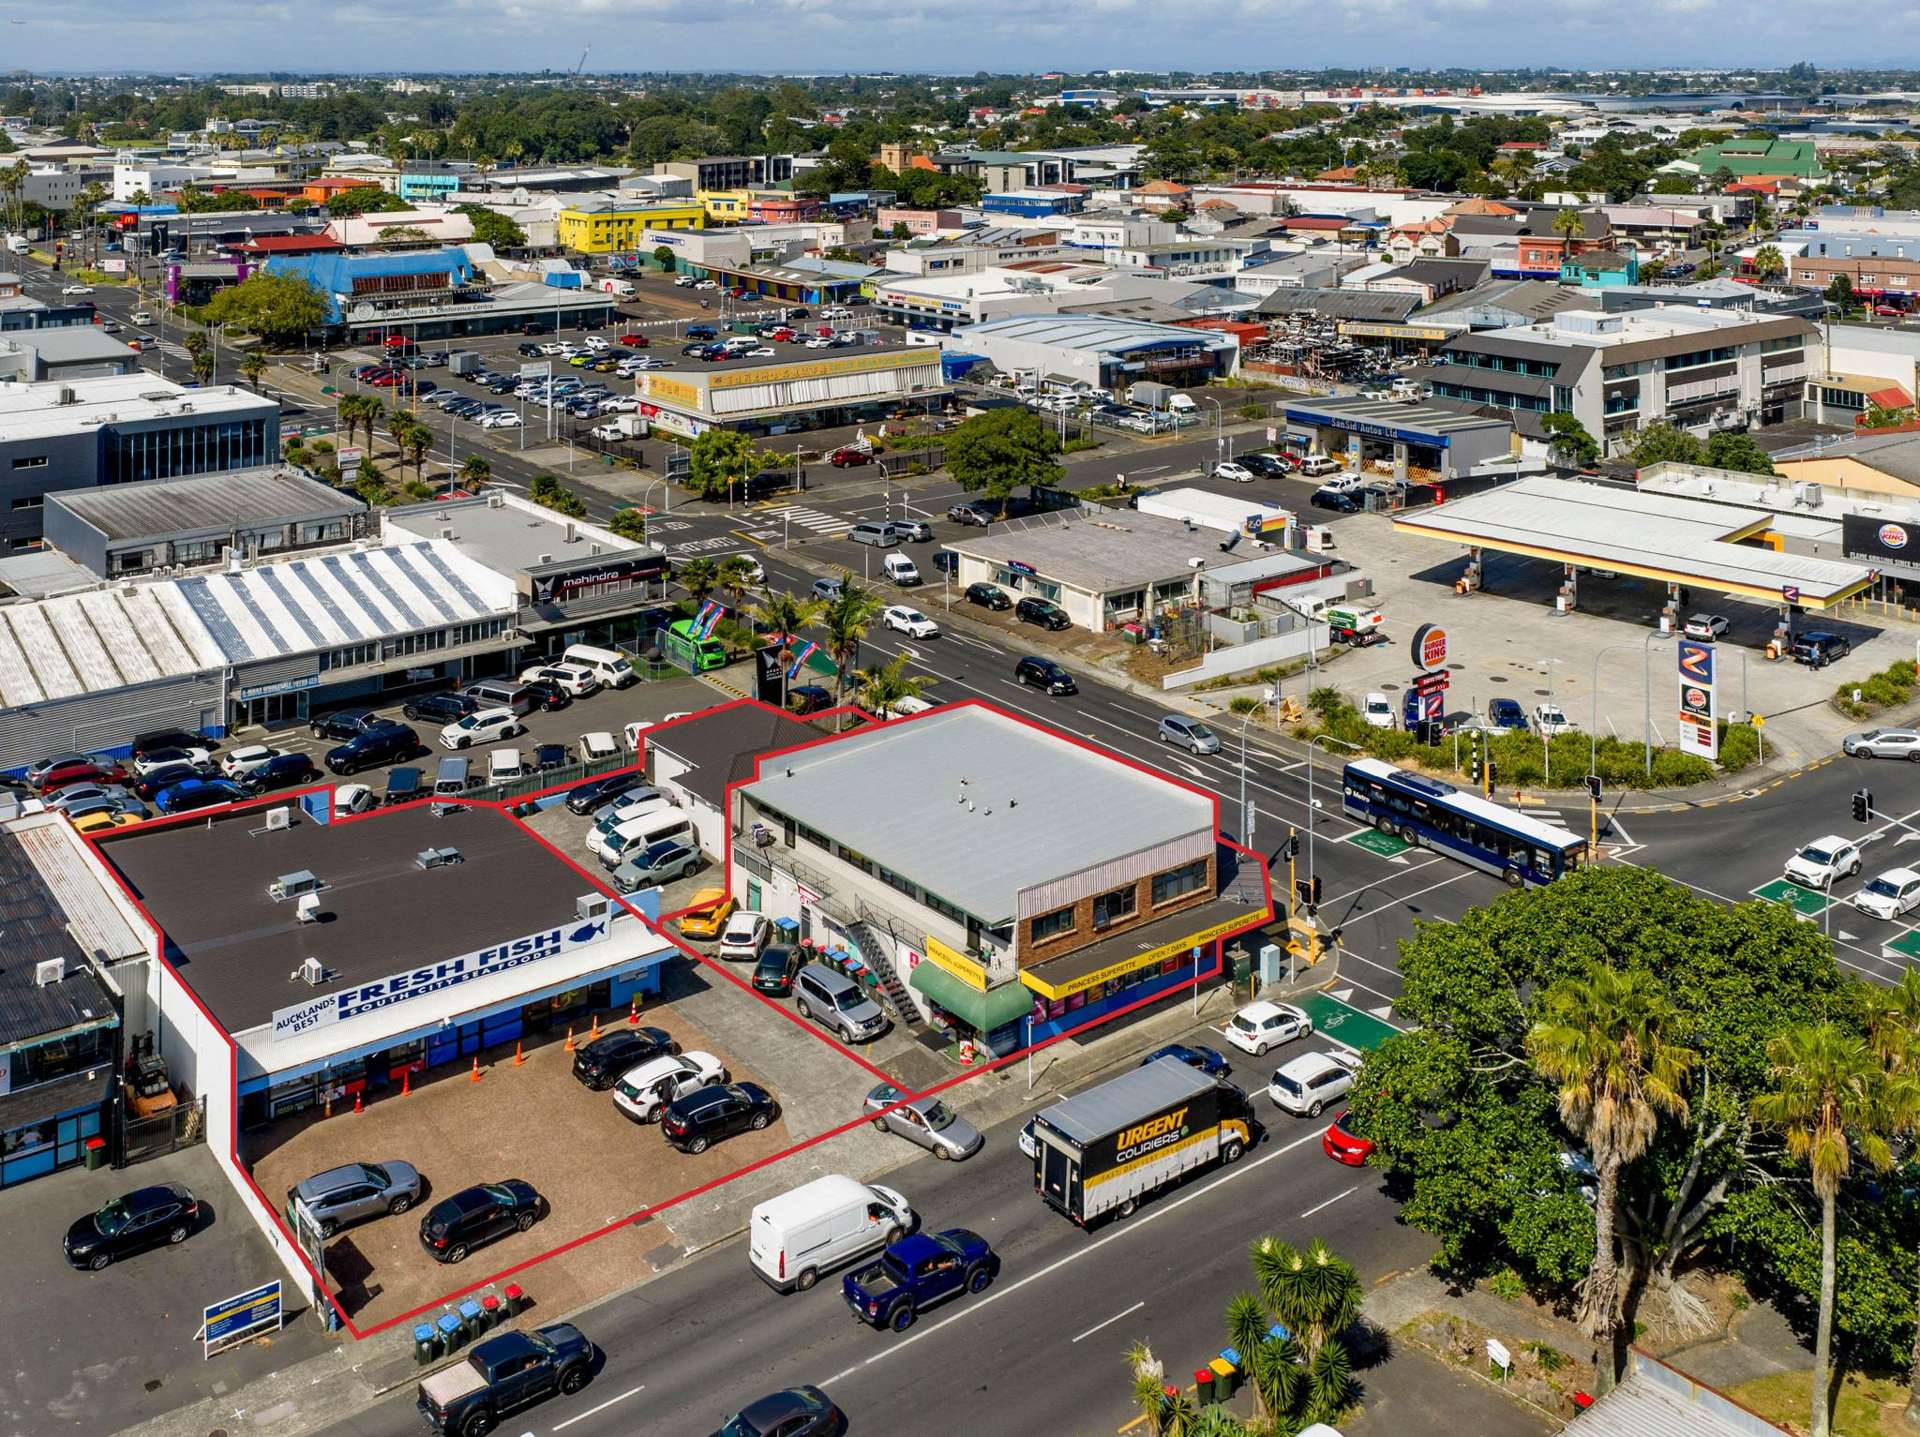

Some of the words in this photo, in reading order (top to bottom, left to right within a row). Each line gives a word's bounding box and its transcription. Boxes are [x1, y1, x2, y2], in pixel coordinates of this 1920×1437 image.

[406, 308, 428, 316] Events
[436, 304, 472, 314] Conference
[1391, 327, 1424, 338] SPARES
[1331, 416, 1357, 431] SanSid
[1360, 424, 1383, 436] Autos
[1385, 427, 1398, 439] Ltd
[1881, 533, 1904, 542] KING
[1895, 559, 1912, 568] SINCE
[563, 571, 619, 587] mahindra
[1424, 639, 1446, 650] BURGER
[1424, 646, 1446, 661] KING
[1681, 647, 1708, 676] Z
[1352, 790, 1370, 803] Metro
[1198, 926, 1227, 942] PRINCESS
[1228, 913, 1260, 933] SUPERETTE
[1148, 949, 1164, 962] OPEN
[1171, 941, 1187, 955] DAYS
[338, 958, 465, 1009] FRESH
[479, 930, 561, 966] FISH
[1067, 973, 1099, 992] PRINCESS
[1101, 960, 1137, 982] SUPERETTE
[350, 993, 409, 1015] SOUTH
[418, 977, 454, 994] CITY
[462, 968, 491, 981] SEA
[498, 950, 551, 970] FOODS
[293, 1014, 320, 1032] BEST
[1117, 1106, 1188, 1151] URGENT
[1116, 1130, 1180, 1162] COURIERS
